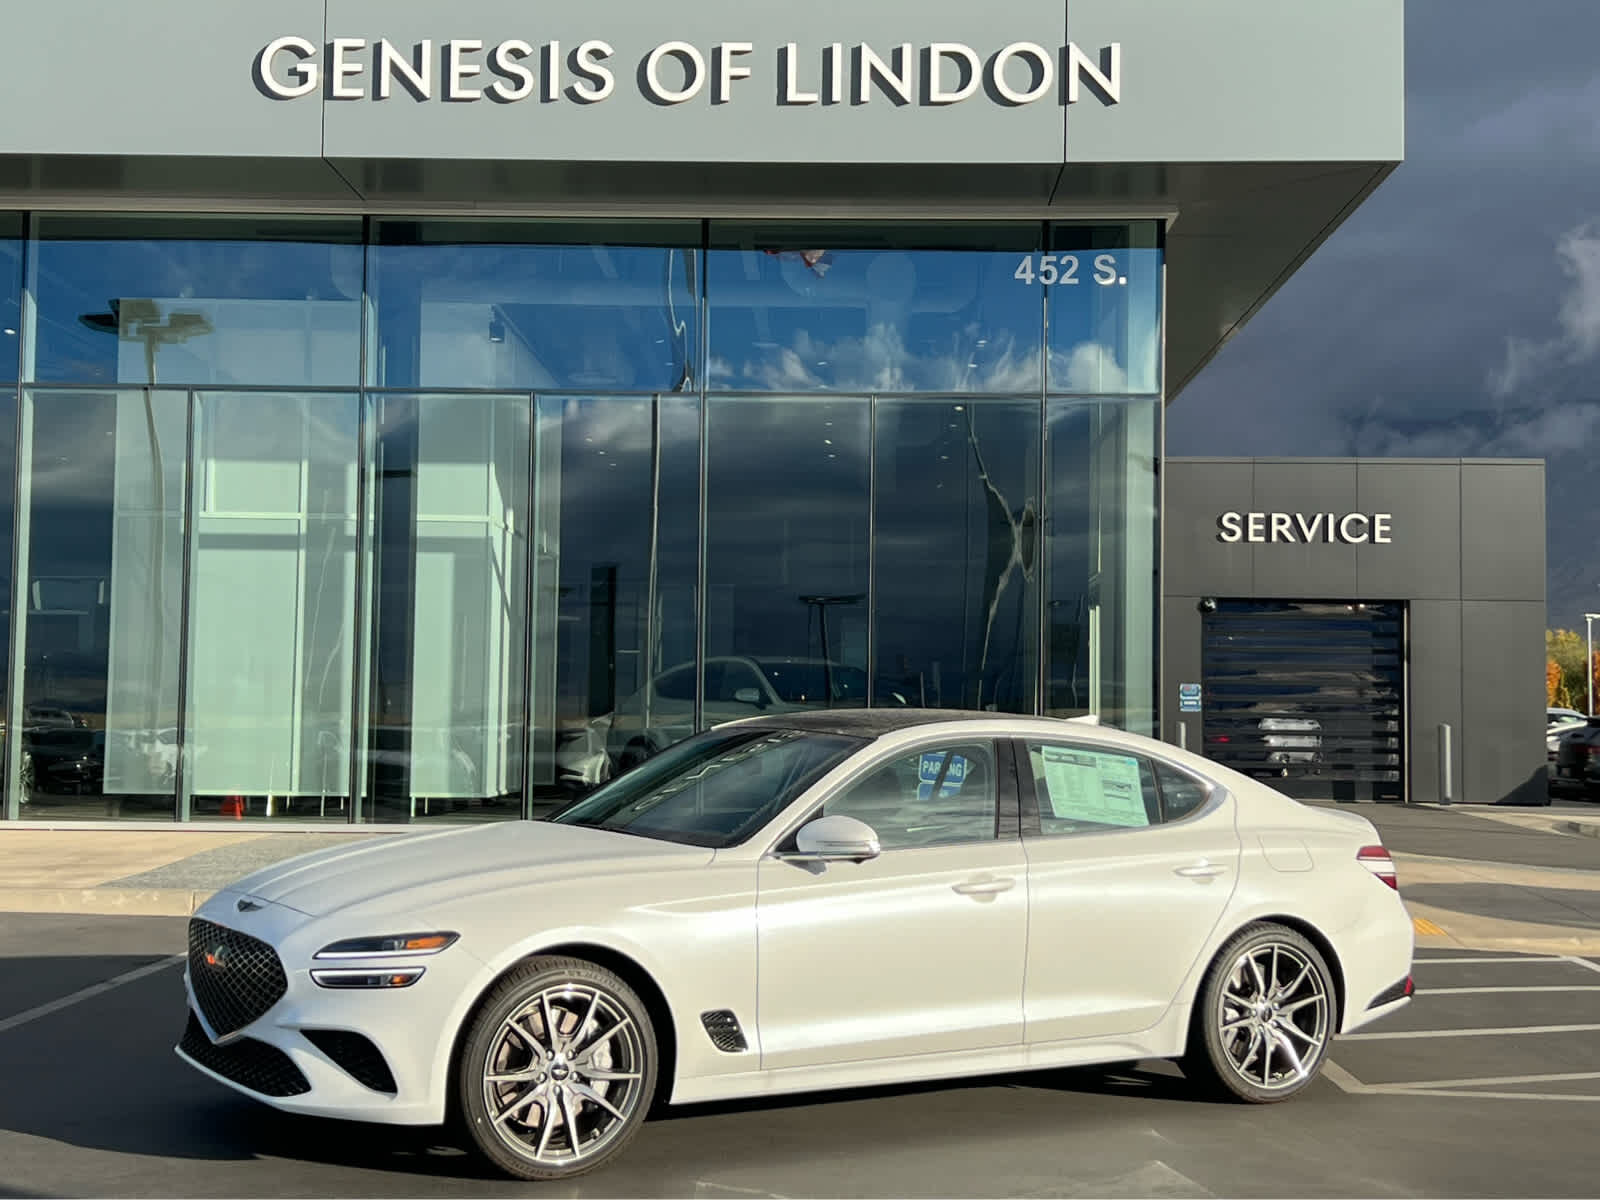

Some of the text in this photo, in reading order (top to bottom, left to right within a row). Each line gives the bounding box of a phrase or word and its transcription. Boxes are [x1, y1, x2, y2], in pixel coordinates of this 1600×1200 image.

[257, 36, 1121, 105] GENESIS OF LINDON
[1014, 254, 1127, 285] 452 S.
[1218, 511, 1393, 544] SERVICE
[922, 760, 963, 777] PARNG
